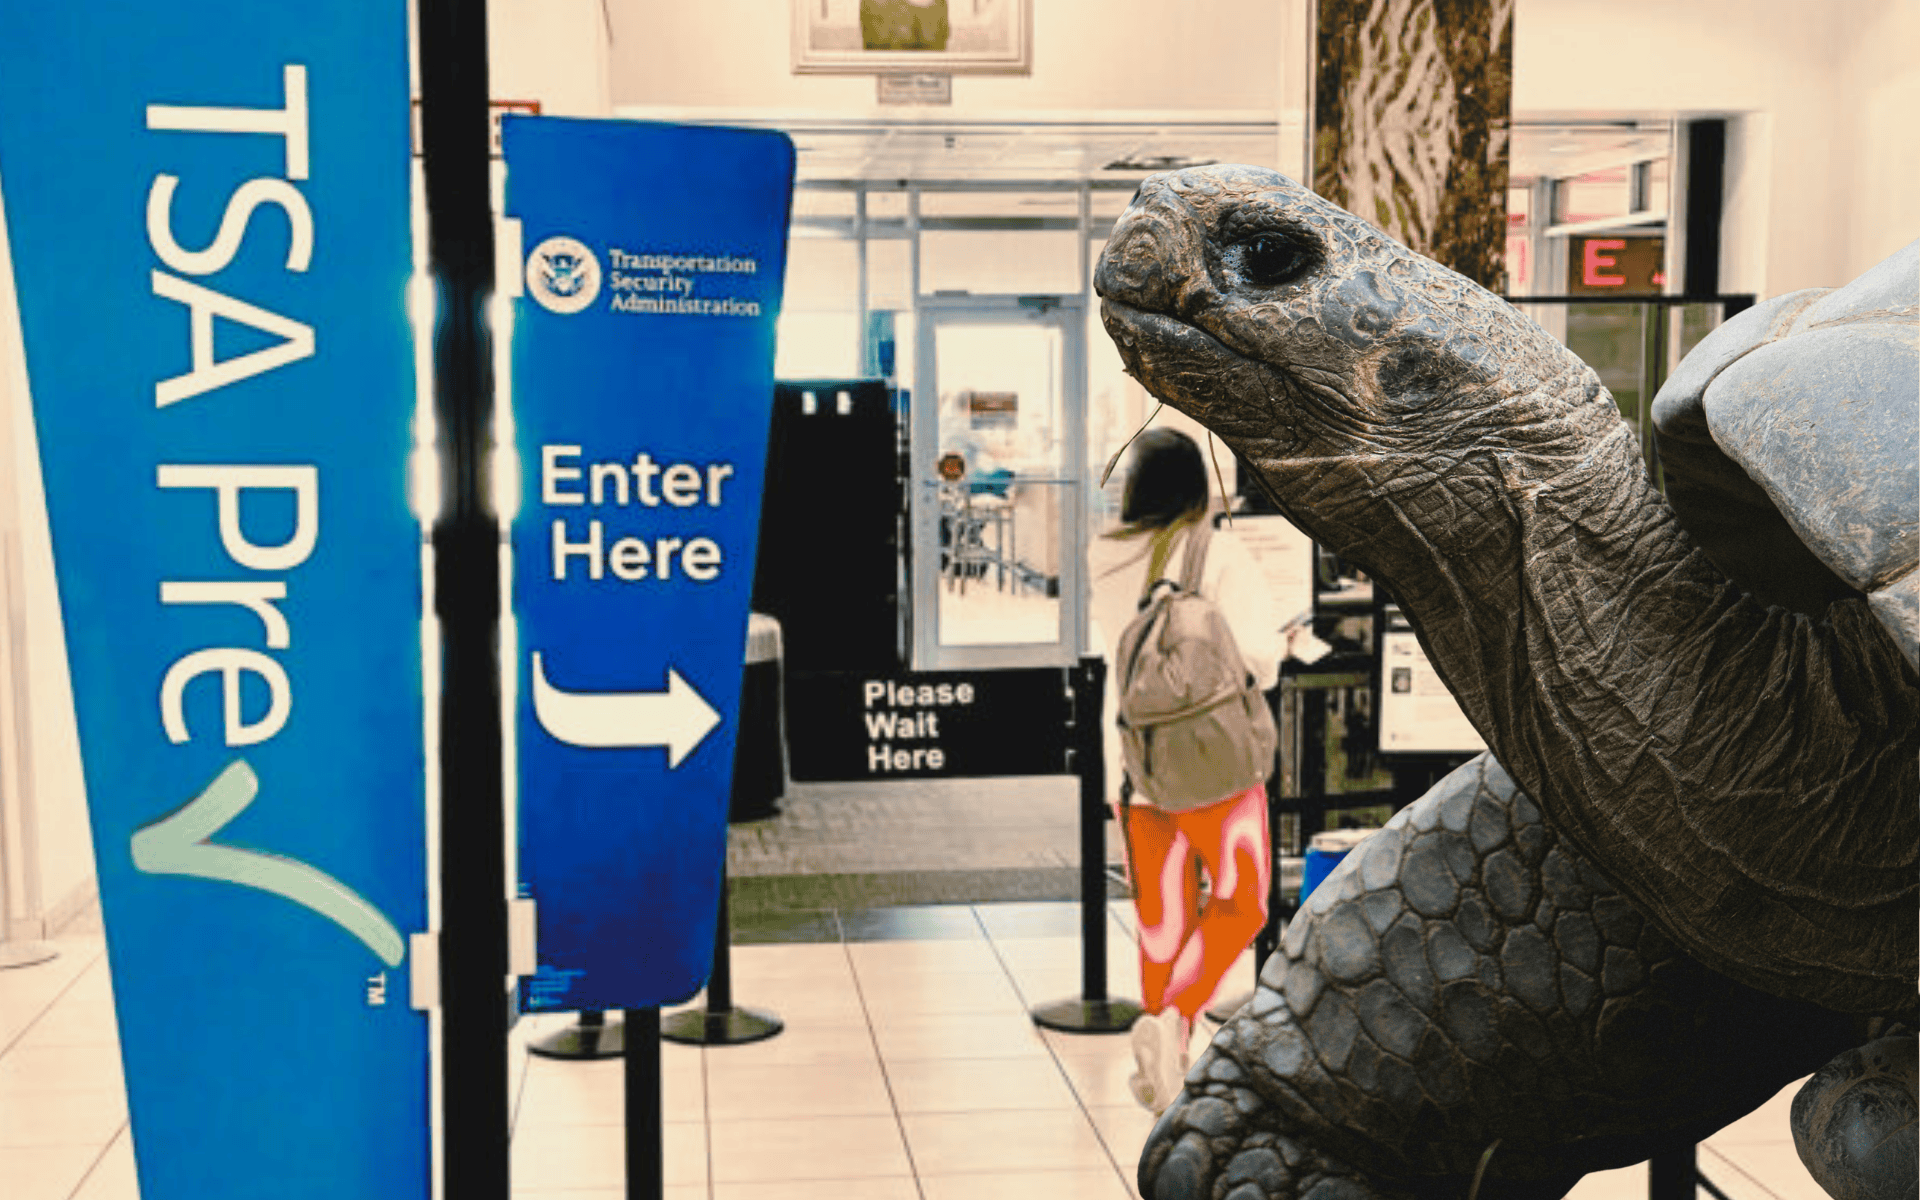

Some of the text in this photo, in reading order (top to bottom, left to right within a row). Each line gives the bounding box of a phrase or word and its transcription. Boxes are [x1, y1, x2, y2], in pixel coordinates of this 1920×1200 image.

[609, 249, 757, 275] Transportation
[611, 271, 693, 297] Security
[610, 293, 762, 317] Administration
[541, 444, 735, 507] Enter
[145, 64, 386, 1006] TSA Pre TM
[553, 519, 722, 580] Here
[864, 680, 976, 708] Please
[864, 711, 939, 740] Wait
[867, 743, 946, 772] Here
